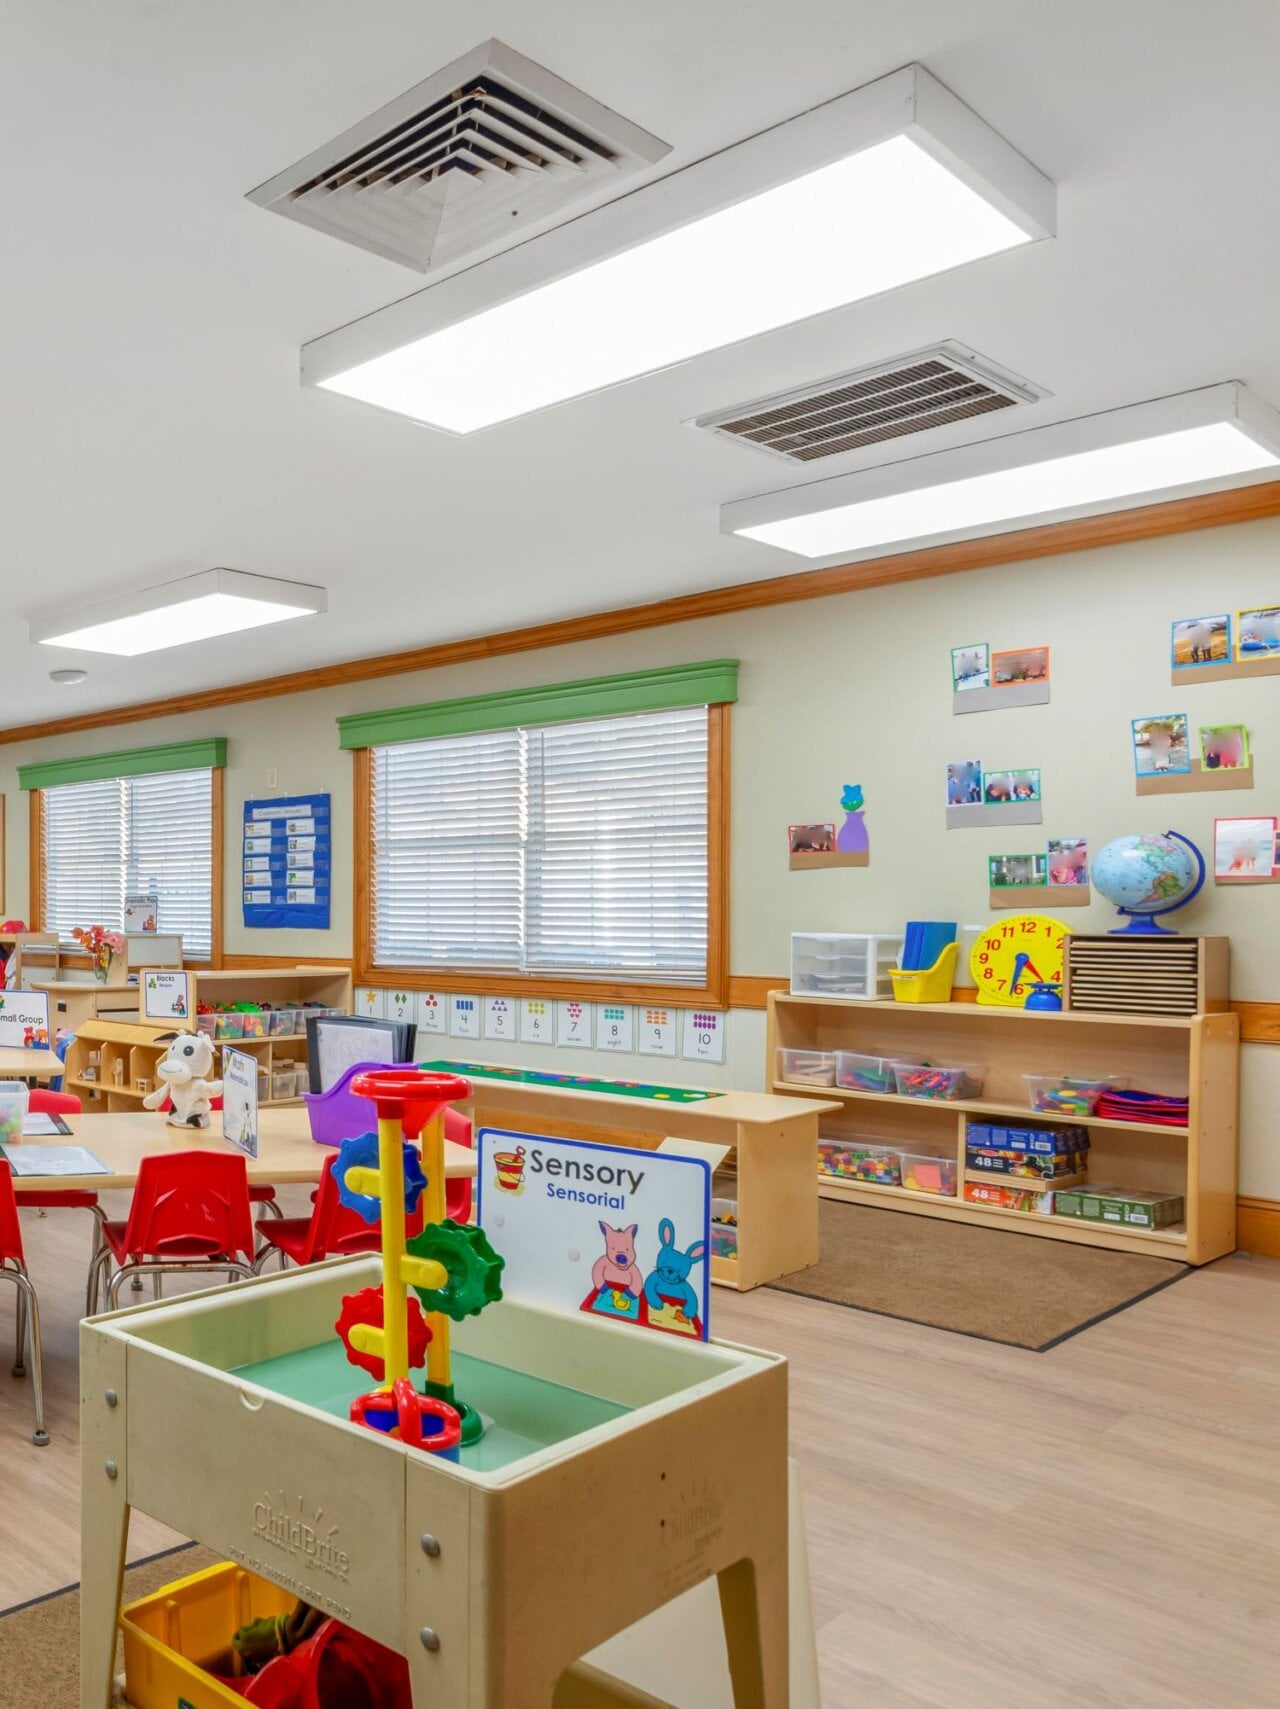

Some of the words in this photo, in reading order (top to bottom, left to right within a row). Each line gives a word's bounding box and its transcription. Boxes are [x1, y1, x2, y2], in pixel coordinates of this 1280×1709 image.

[1001, 926, 1015, 938] 11
[1020, 921, 1037, 933] 12
[1044, 926, 1052, 938] 1
[985, 939, 1002, 951] 10
[1056, 937, 1064, 949] 2
[979, 952, 989, 964] 9
[156, 974, 175, 982] Blocks
[983, 967, 993, 979] 8
[1051, 970, 1061, 982] 4
[997, 979, 1007, 991] 7
[1014, 983, 1024, 995] 6
[397, 1007, 404, 1017] 2
[429, 1010, 435, 1020] 3
[19, 1013, 44, 1025] Group
[461, 1014, 468, 1024] 4
[497, 1015, 503, 1026] 5
[533, 1018, 540, 1029] 6
[571, 1021, 578, 1032] 7
[611, 1025, 618, 1036] 8
[654, 1028, 661, 1040] 9
[698, 1033, 711, 1045] 10
[975, 1156, 992, 1167] 48
[529, 1149, 645, 1195] Sensory
[546, 1182, 626, 1210] Sensorial
[971, 1188, 989, 1199] 48
[253, 1502, 351, 1573] ChildBrite
